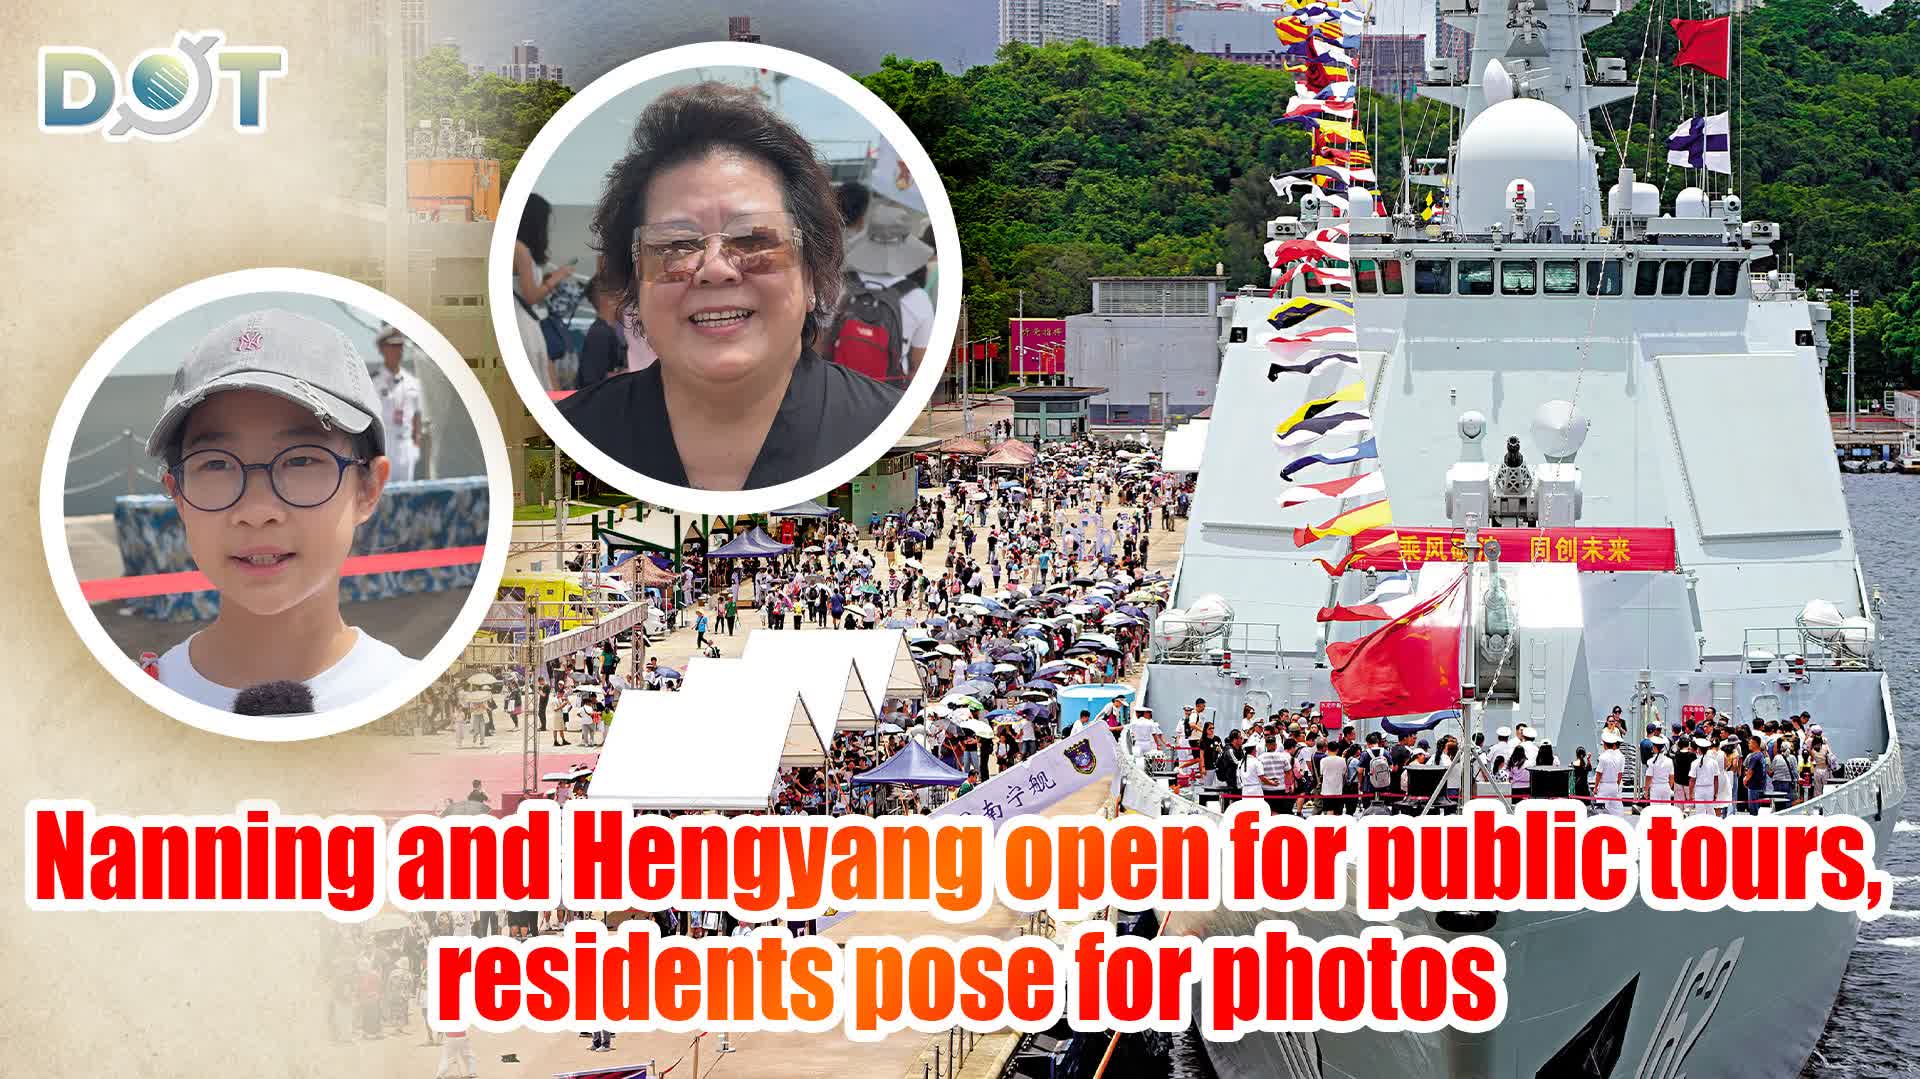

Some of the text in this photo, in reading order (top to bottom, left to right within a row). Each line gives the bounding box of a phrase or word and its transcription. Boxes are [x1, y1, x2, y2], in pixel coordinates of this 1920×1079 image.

[1530, 536, 1632, 563] 同创未来
[959, 770, 1057, 821] 南宁舰
